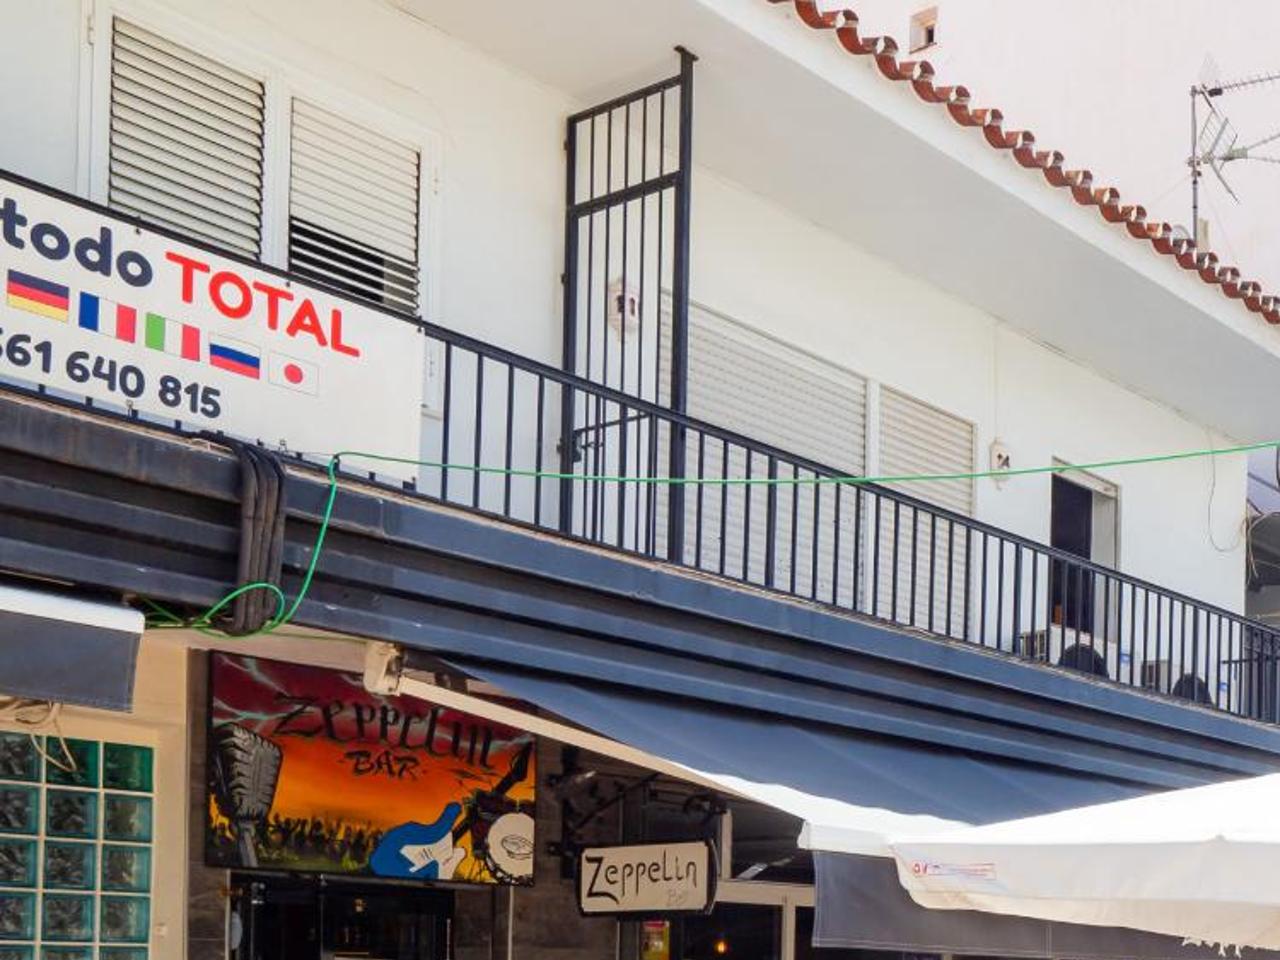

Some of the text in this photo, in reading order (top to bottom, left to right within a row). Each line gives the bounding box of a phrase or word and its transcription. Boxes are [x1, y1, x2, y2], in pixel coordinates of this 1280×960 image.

[0, 197, 361, 358] todo TOTAL
[0, 326, 221, 419] 61 640 815
[345, 750, 420, 781] BAR
